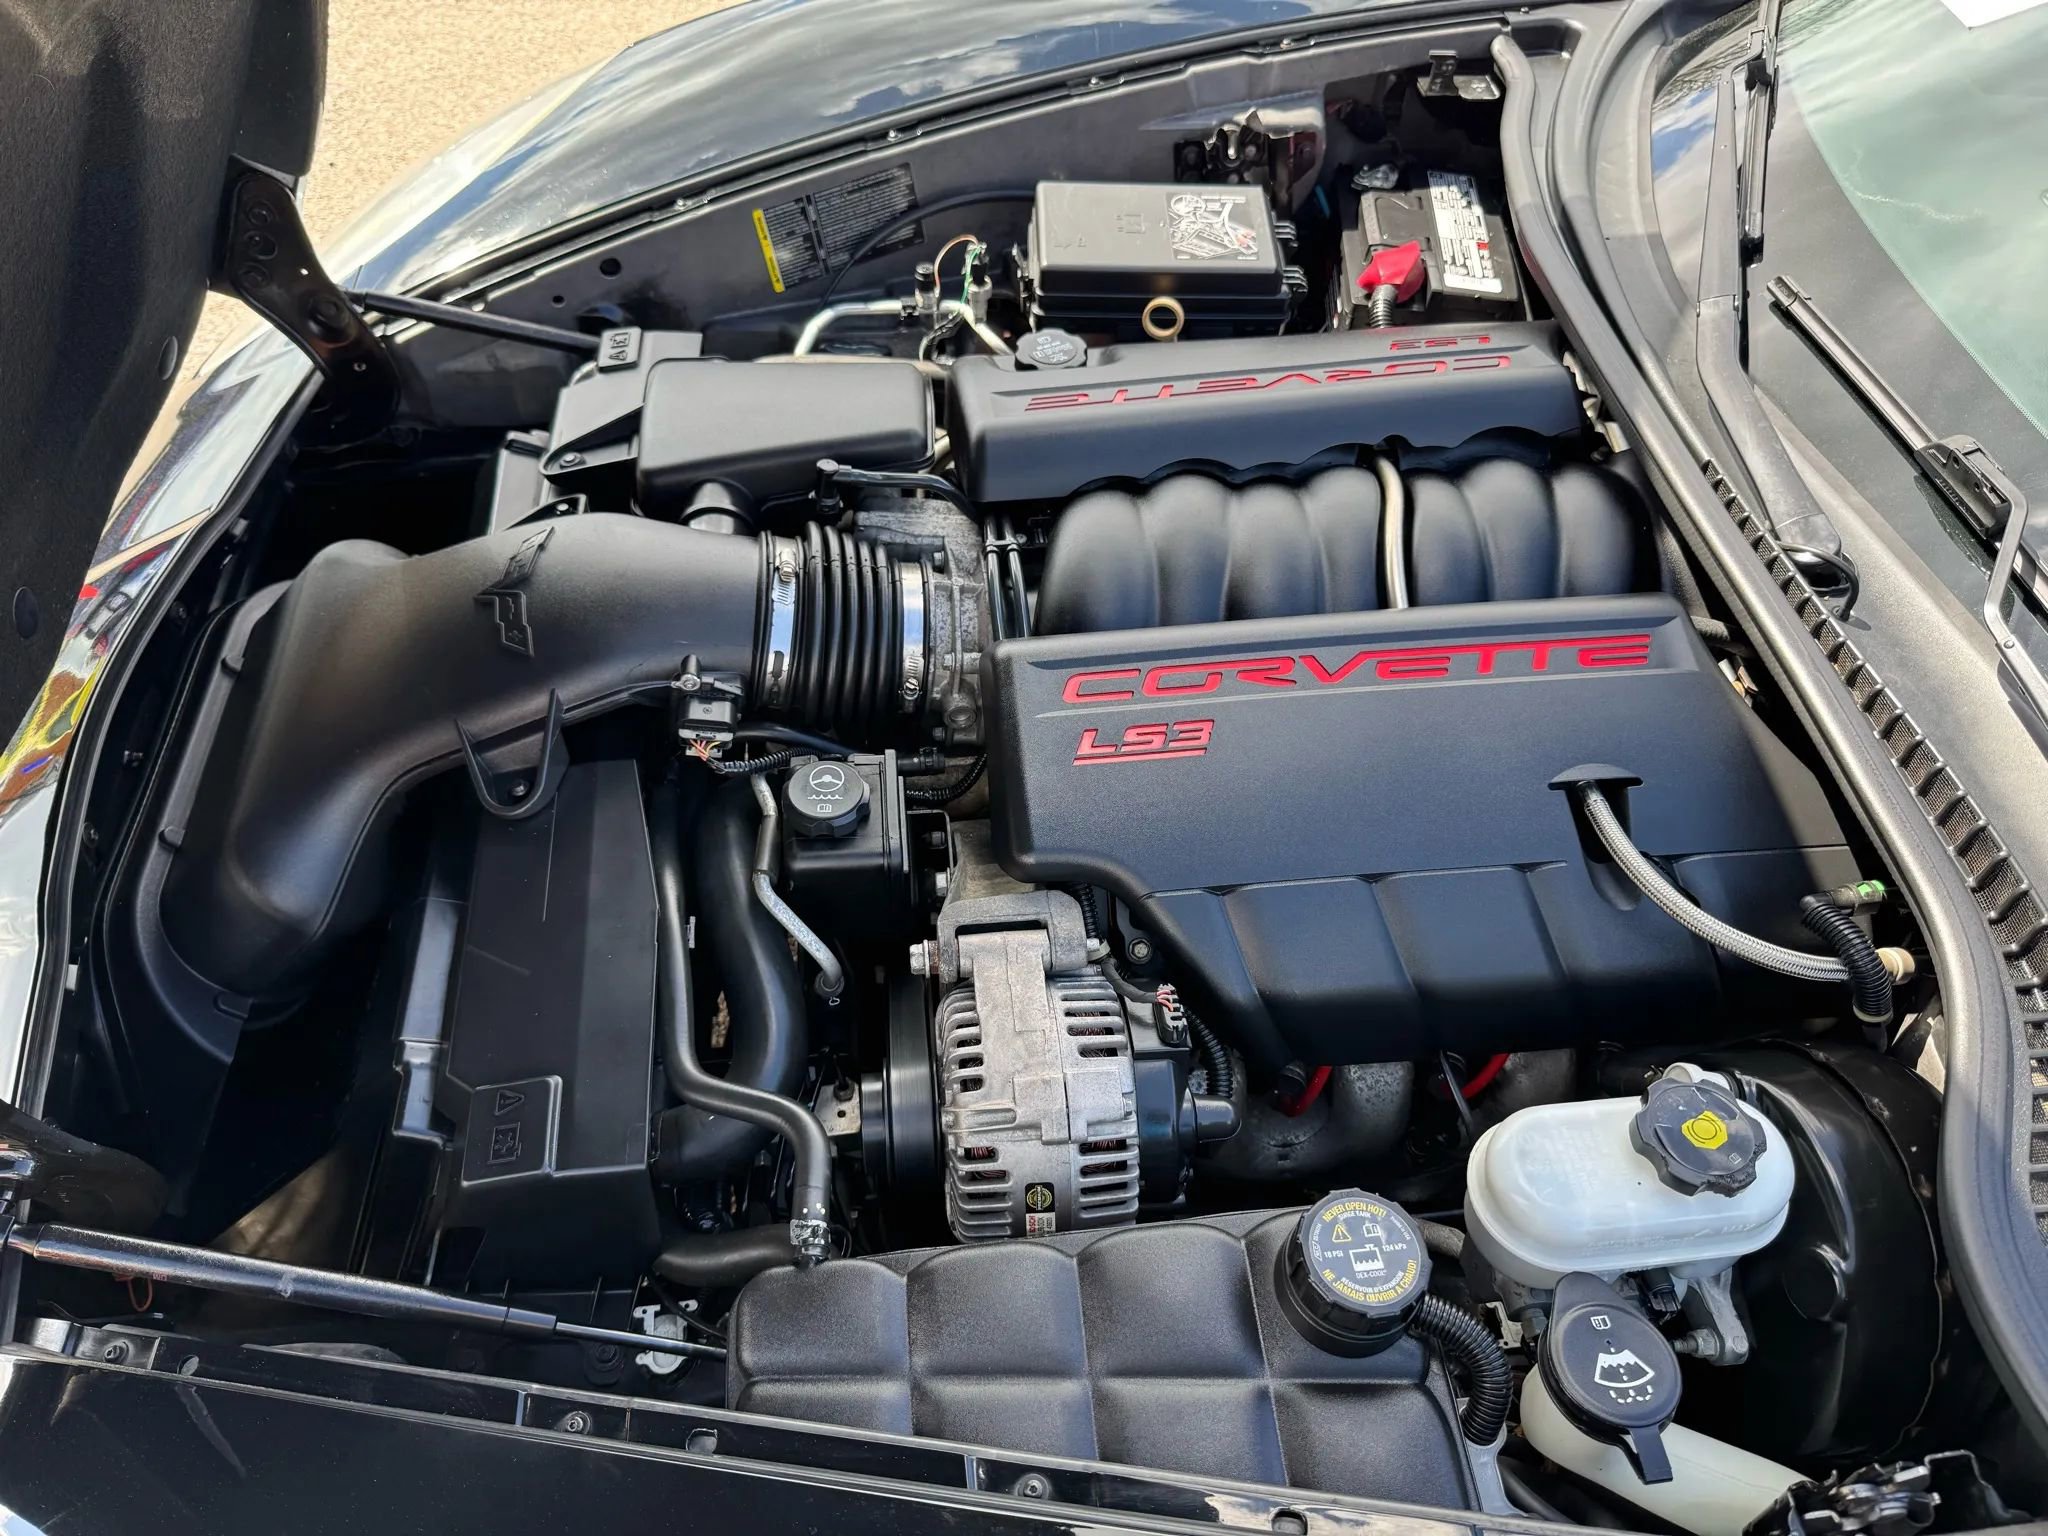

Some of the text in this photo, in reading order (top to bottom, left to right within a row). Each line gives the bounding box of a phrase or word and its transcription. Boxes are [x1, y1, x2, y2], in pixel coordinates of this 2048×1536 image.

[1389, 336, 1490, 350] LS3
[1024, 355, 1512, 411] CORVETTE
[1062, 634, 1651, 704] CORVETTE
[1075, 719, 1215, 756] LS3
[1322, 1201, 1387, 1222] NEVER OPEN HOT!
[1332, 1249, 1344, 1257] PSI
[1394, 1242, 1407, 1251] kPa
[1322, 1269, 1336, 1281] NE
[1332, 1280, 1365, 1301] JAMAIS
[1366, 1290, 1397, 1302] OUVRIR
[1403, 1259, 1417, 1288] CHAUD!
